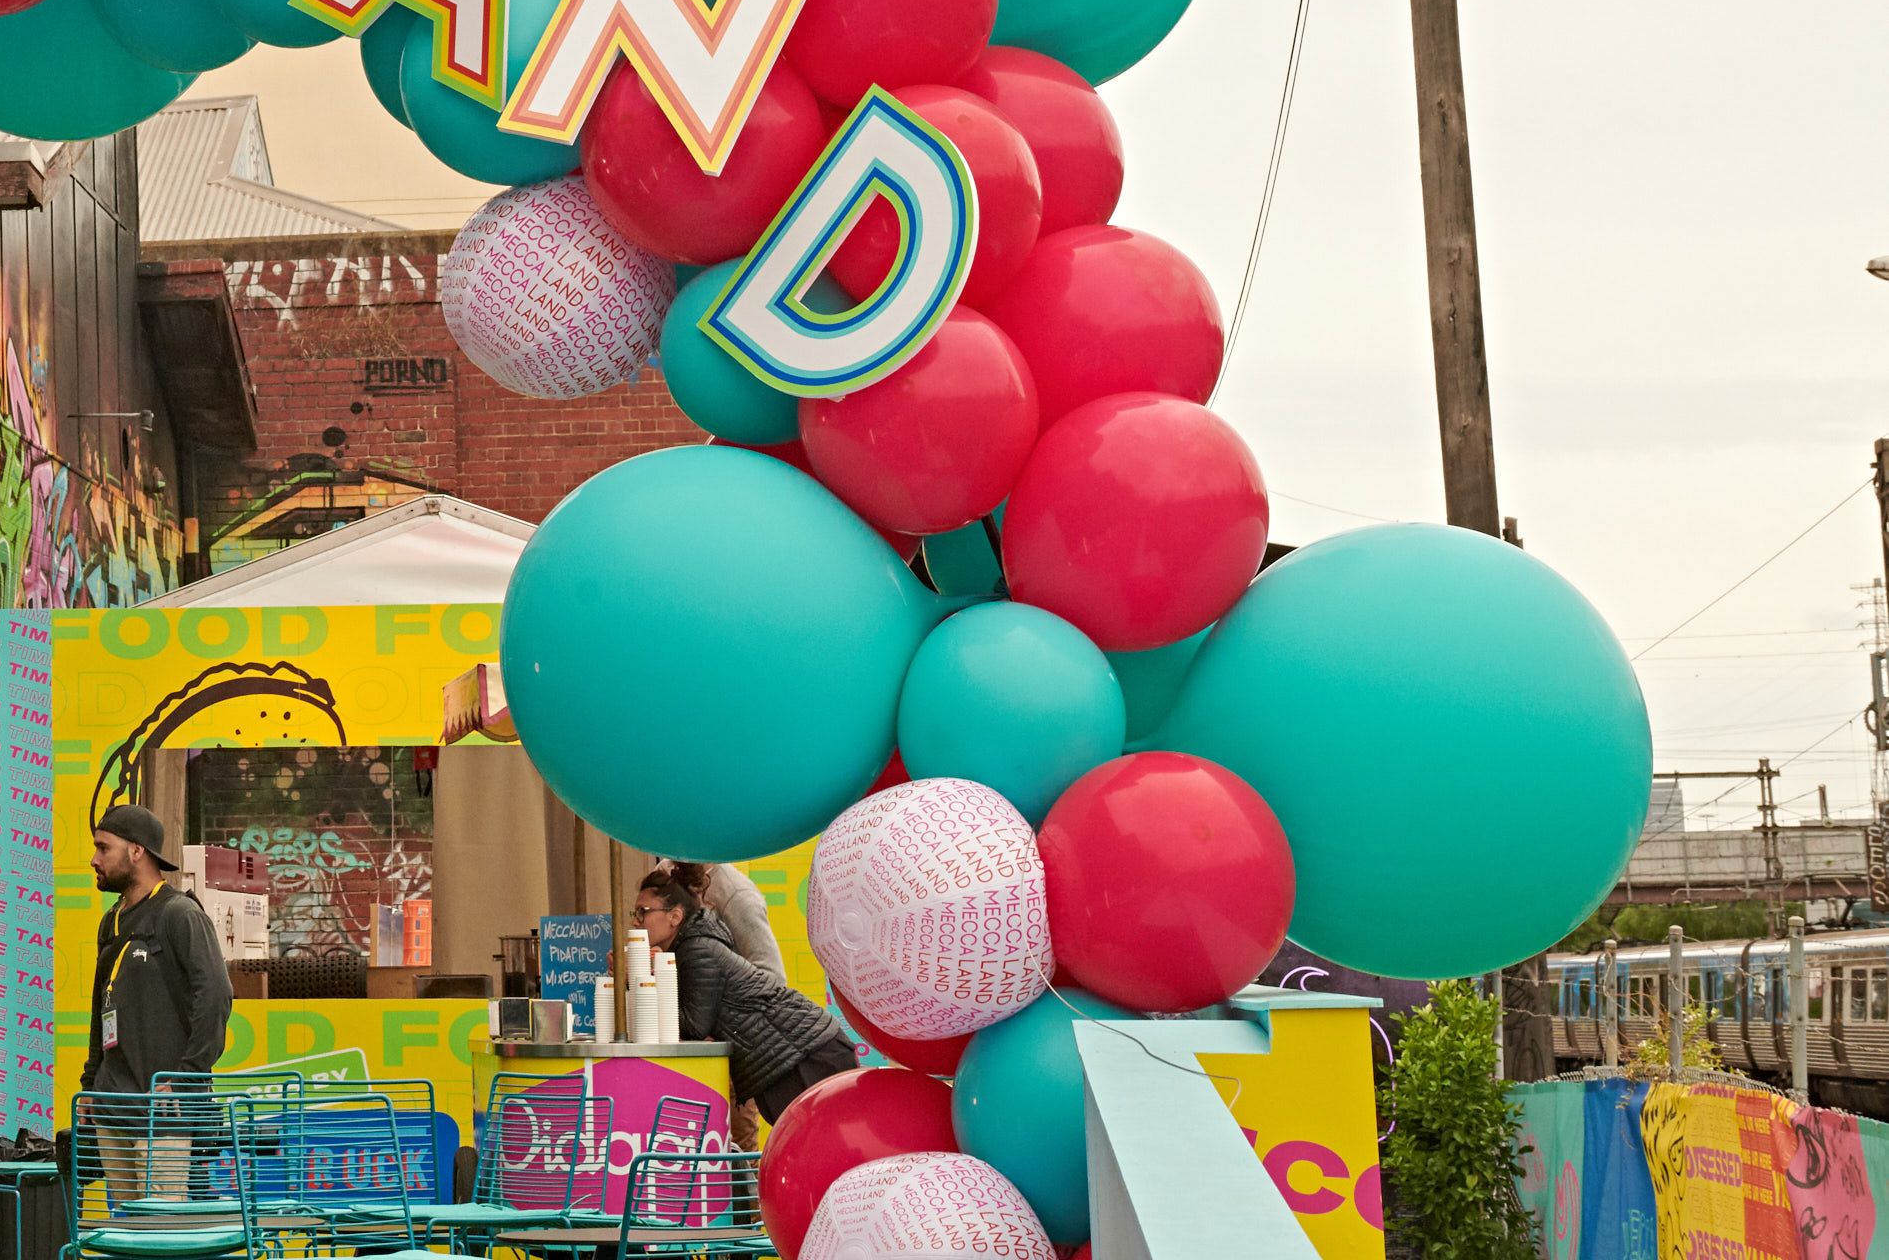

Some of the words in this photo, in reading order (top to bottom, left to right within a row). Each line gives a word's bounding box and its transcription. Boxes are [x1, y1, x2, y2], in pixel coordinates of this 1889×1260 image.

[9, 621, 51, 644] TIM
[9, 662, 51, 685] TIM
[9, 683, 52, 706] TIM
[9, 703, 51, 726] TIM
[9, 724, 52, 749] TIM
[9, 745, 51, 768] TIM
[9, 766, 52, 791] TIM
[9, 786, 51, 810] TIM
[9, 807, 52, 833] TIM
[9, 828, 51, 852] TIM
[543, 921, 602, 940] MECCALAND
[544, 969, 577, 987] MIXED
